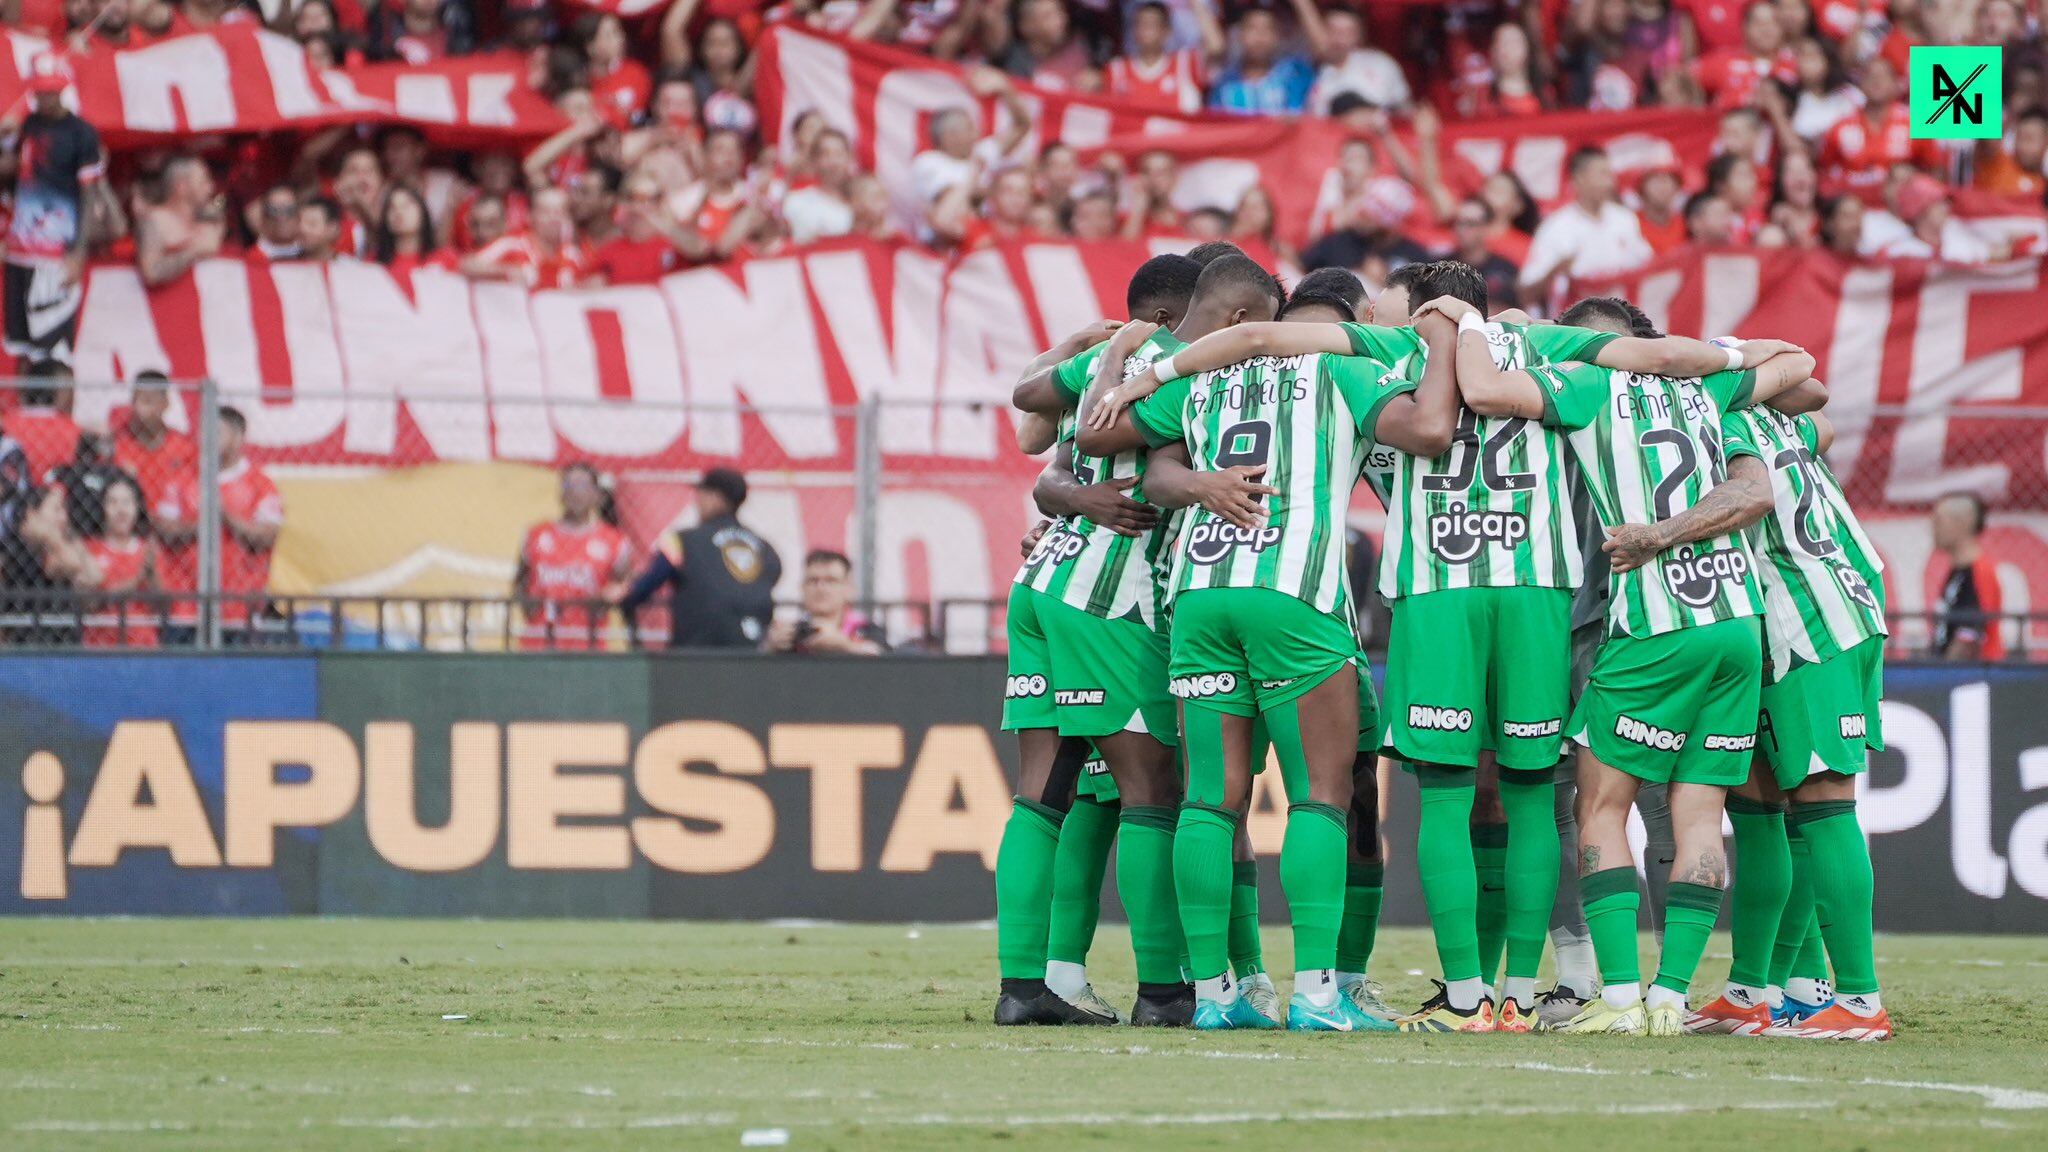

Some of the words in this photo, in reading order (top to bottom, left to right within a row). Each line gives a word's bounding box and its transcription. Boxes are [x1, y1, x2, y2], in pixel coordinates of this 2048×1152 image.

[1190, 377, 1309, 415] A.MORELOS
[1214, 419, 1272, 508] 9
[1187, 516, 1280, 553] picap
[1432, 503, 1526, 549] picap
[1665, 550, 1747, 595] picap
[1170, 672, 1236, 698] RINGO
[1409, 705, 1472, 731] RINGO
[1504, 719, 1561, 738] SPORTLINE
[1615, 715, 1687, 752] RINGO
